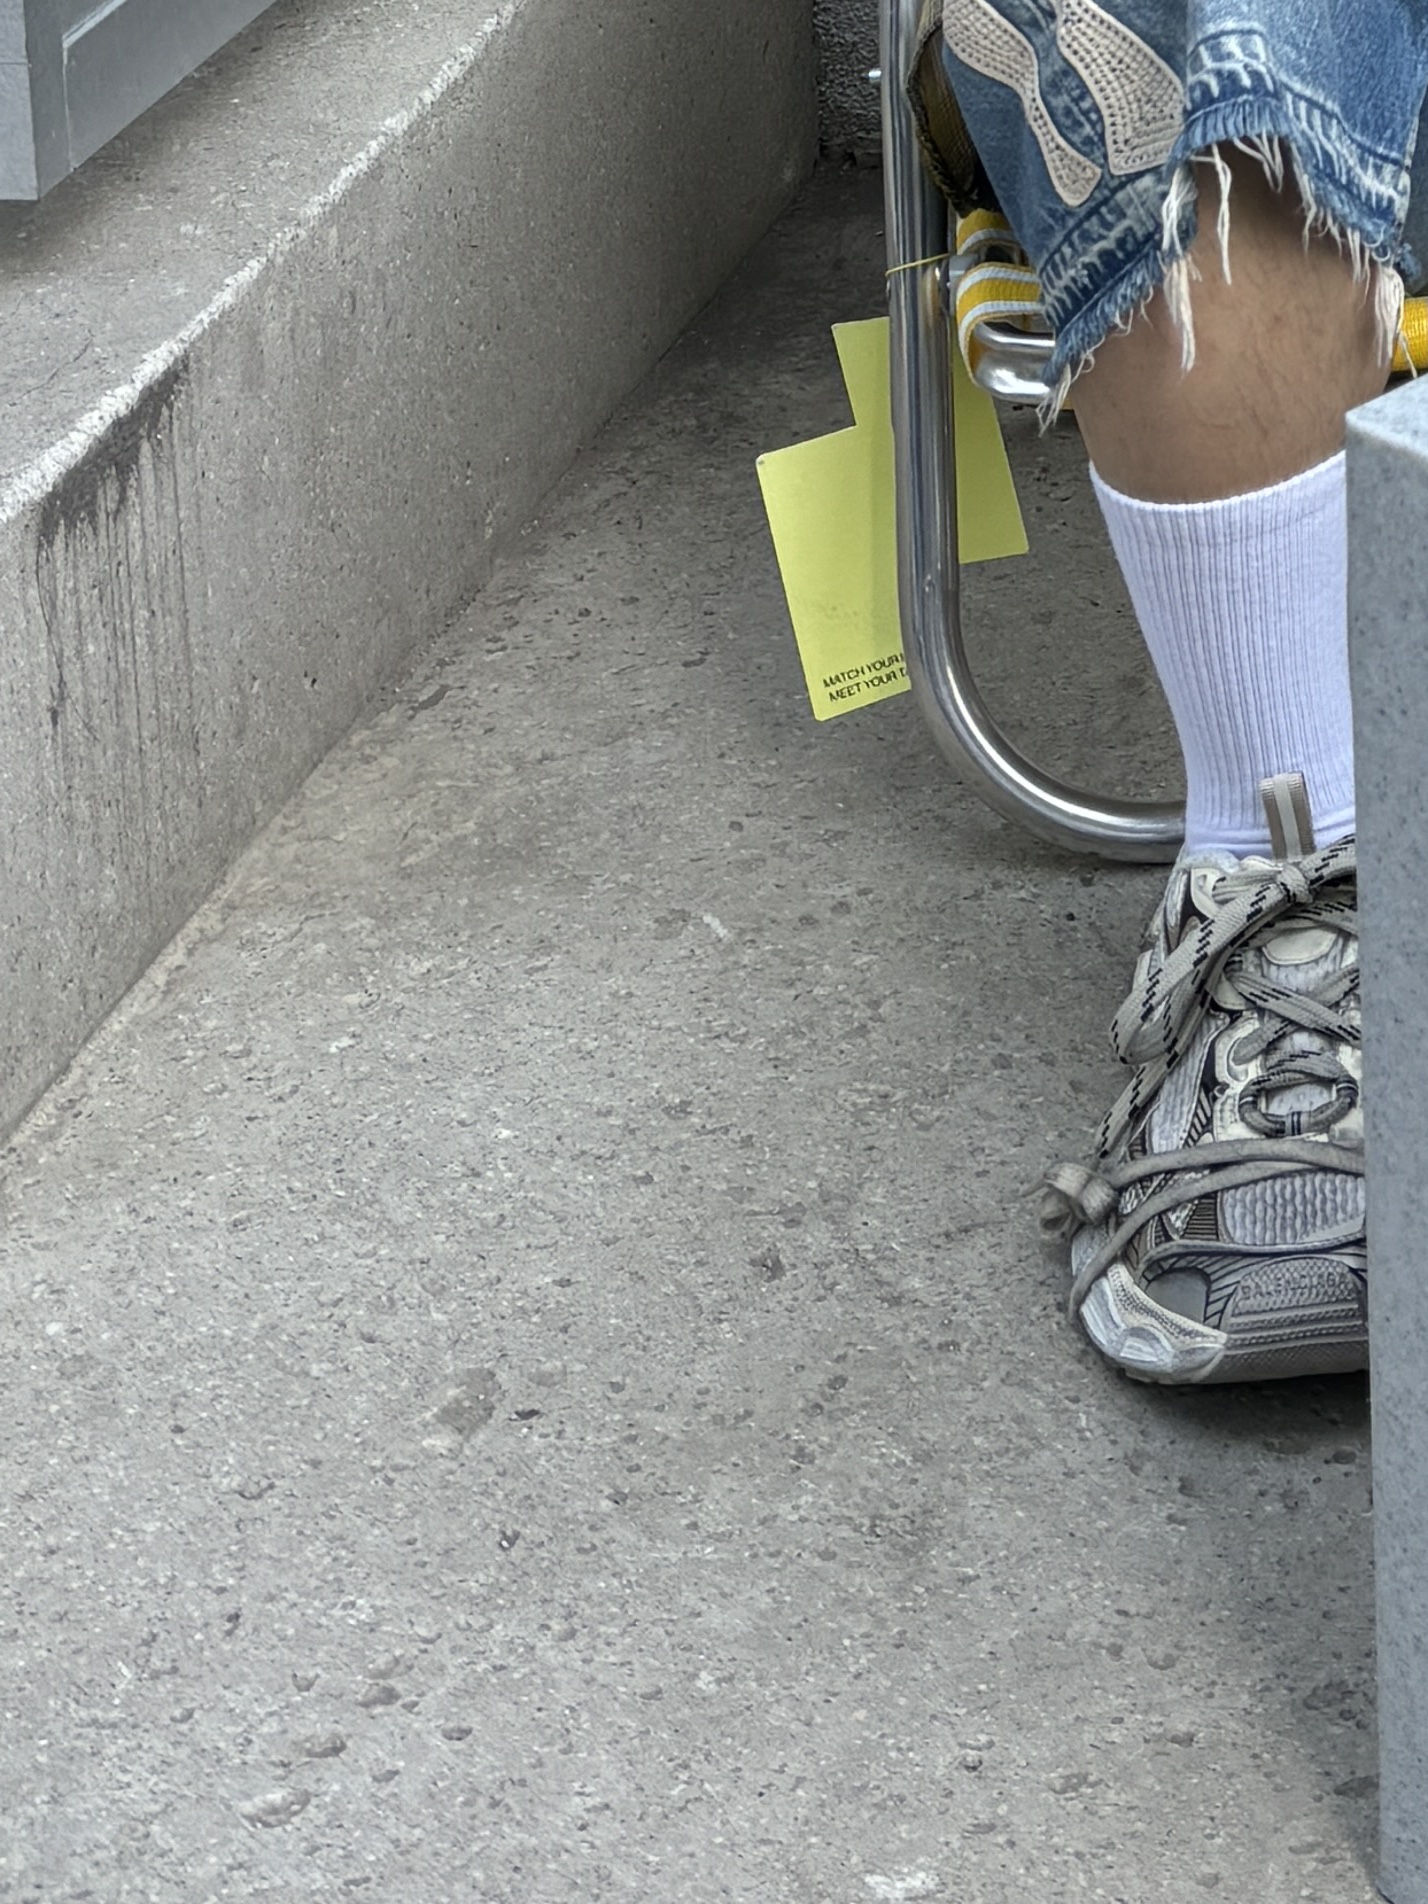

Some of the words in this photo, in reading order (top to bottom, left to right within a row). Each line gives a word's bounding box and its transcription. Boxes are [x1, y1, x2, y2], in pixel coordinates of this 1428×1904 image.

[823, 665, 866, 688] MATCH
[866, 654, 900, 673] YOUR
[828, 682, 861, 702] MEET
[863, 670, 899, 689] YOUR
